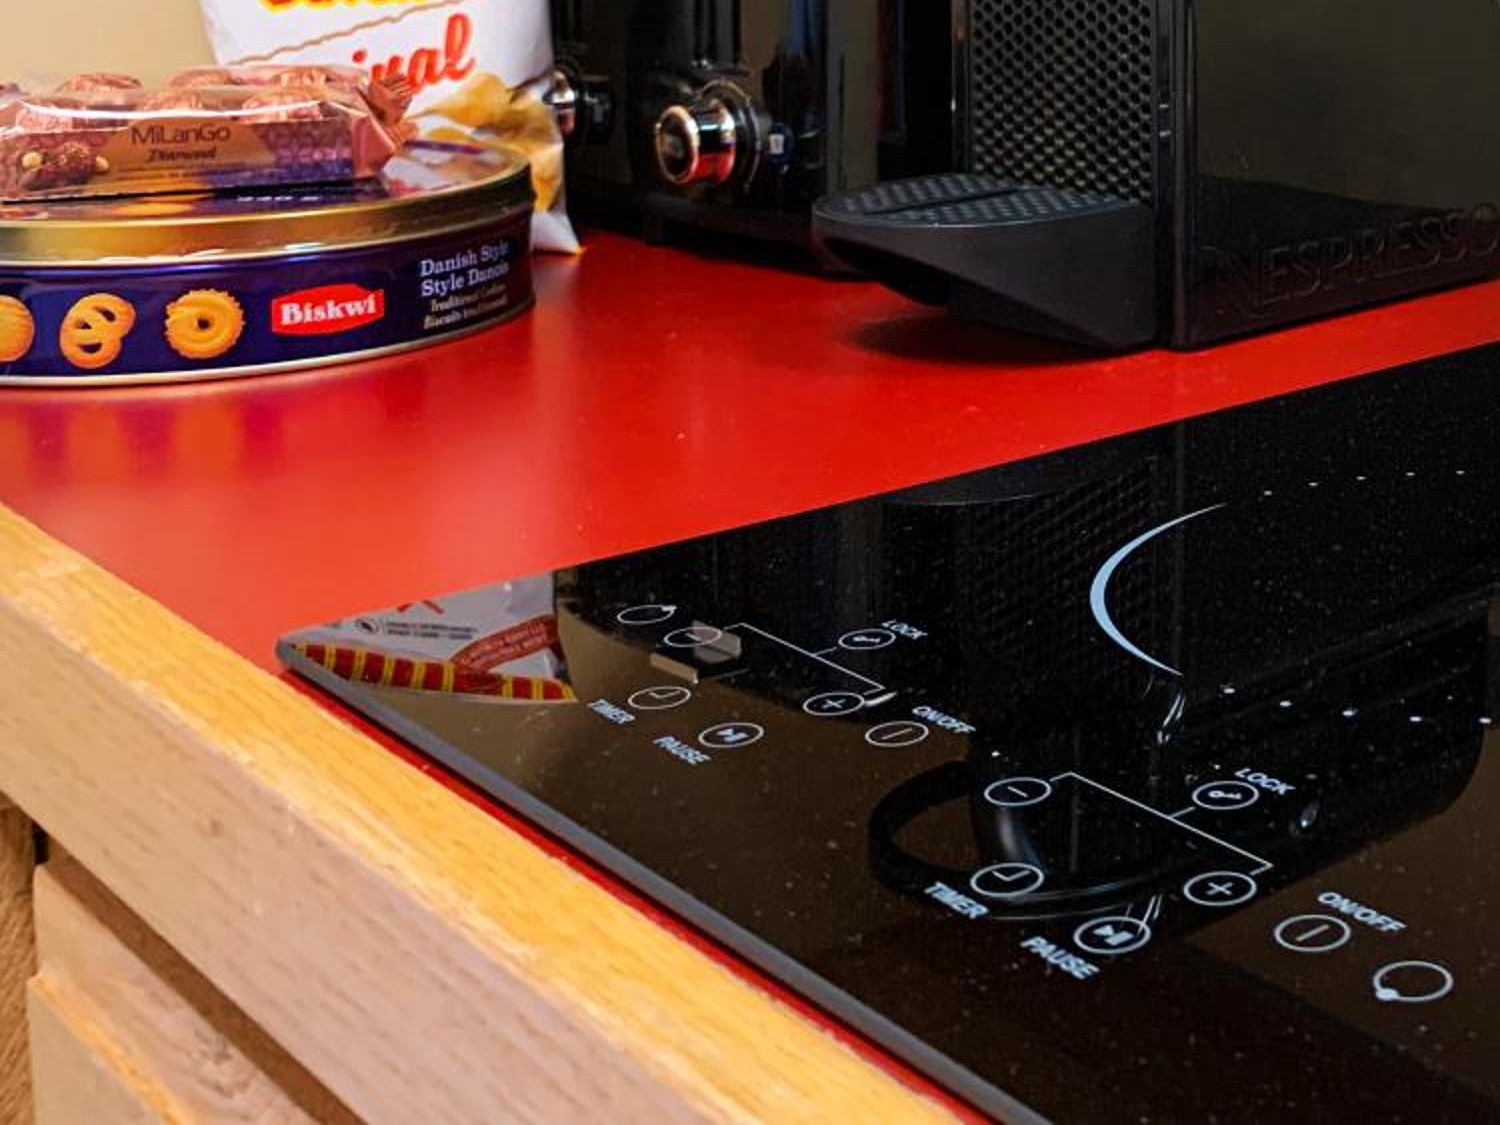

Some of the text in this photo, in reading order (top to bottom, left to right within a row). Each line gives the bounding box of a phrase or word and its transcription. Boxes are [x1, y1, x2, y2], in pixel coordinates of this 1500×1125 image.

[420, 249, 478, 277] Danish
[1199, 201, 1500, 319] NESPRESSO
[420, 273, 465, 296] Style
[281, 293, 377, 326] Biskwi
[880, 619, 929, 640] LOCK
[911, 704, 976, 736] ON/OFF
[652, 734, 712, 765] PAUSE
[1234, 767, 1296, 796] LOCK
[923, 880, 989, 920] TIMER
[1316, 890, 1406, 933] ON/OFF
[1019, 934, 1100, 980] PAUSE
